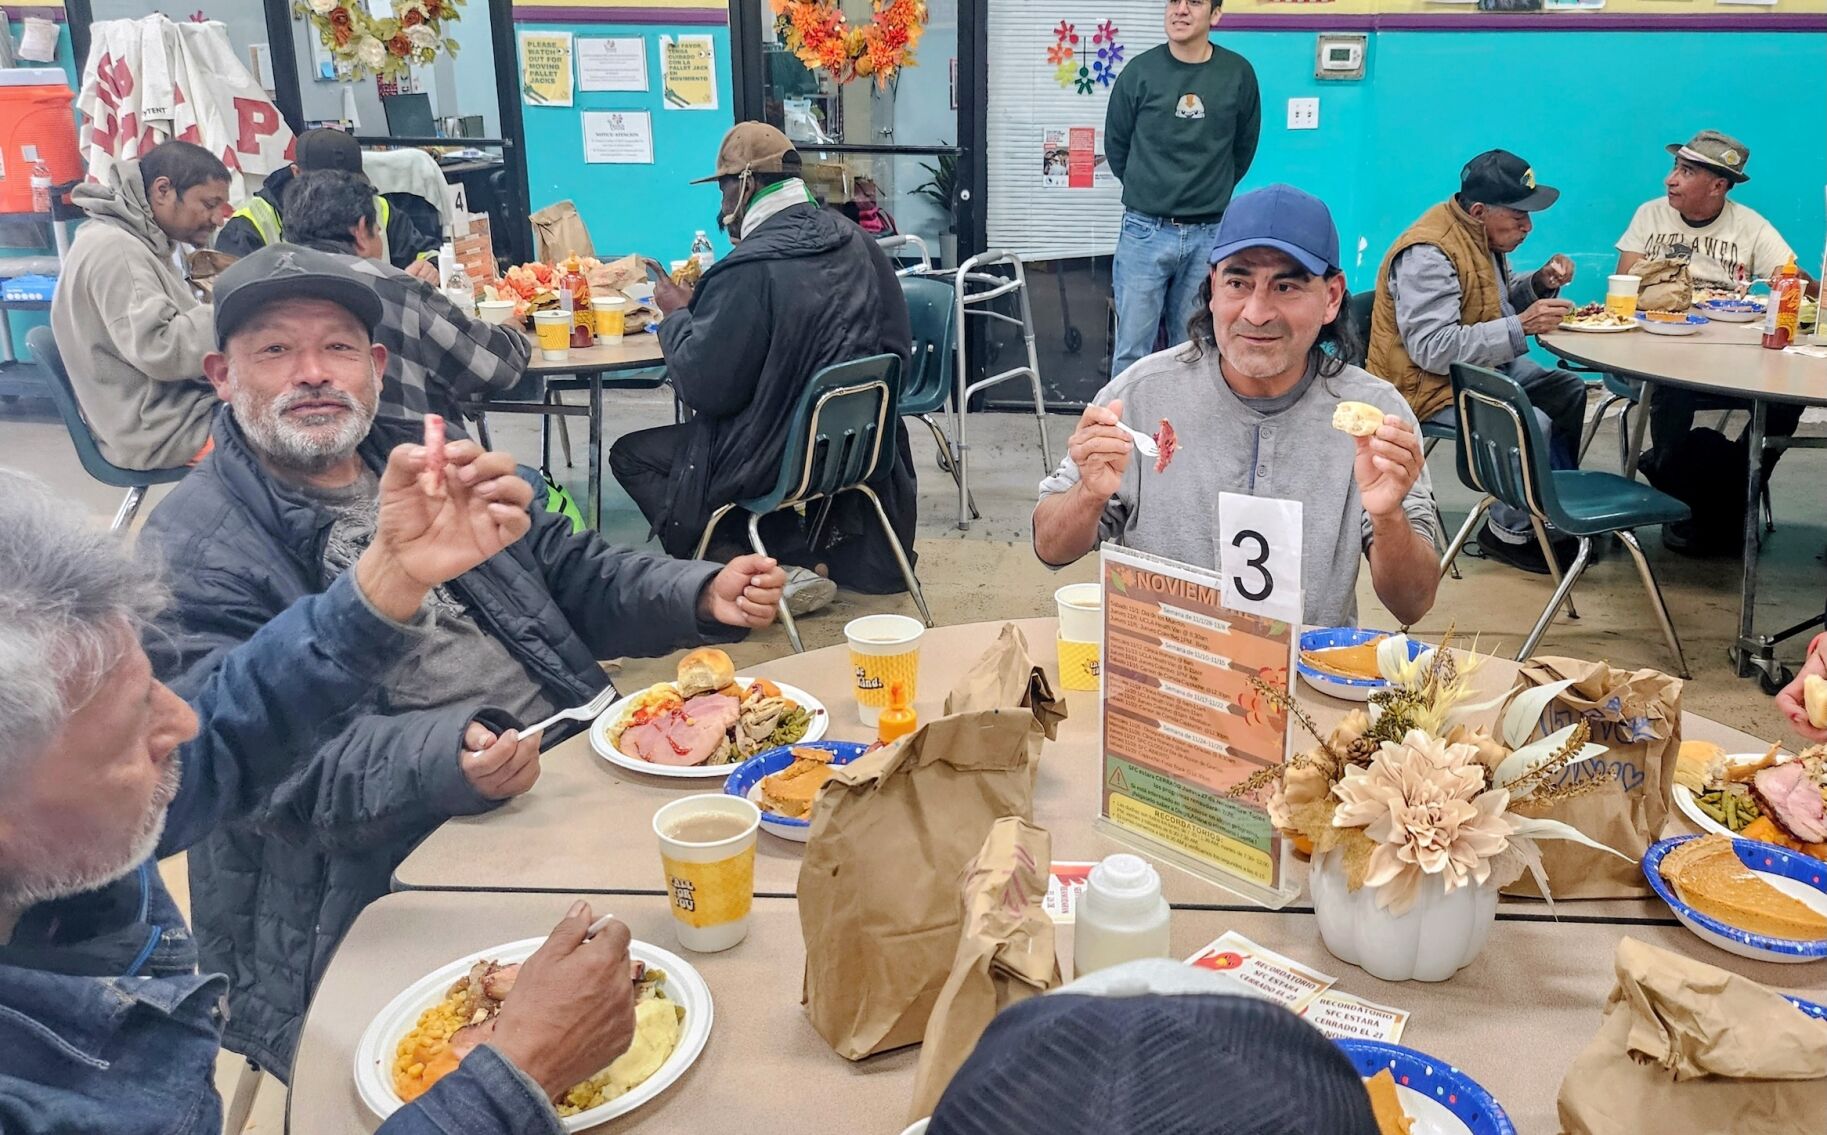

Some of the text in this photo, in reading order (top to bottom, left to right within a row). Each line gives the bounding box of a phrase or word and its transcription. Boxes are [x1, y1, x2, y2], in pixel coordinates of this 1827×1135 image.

[455, 192, 463, 212] 4
[1232, 530, 1274, 602] 3
[1240, 973, 1276, 993] CERRADO
[1276, 989, 1286, 998] EL
[1254, 960, 1316, 990] RECORDATORIO
[1254, 970, 1268, 980] SFC
[1320, 998, 1393, 1020] RECORDATORIO
[1325, 1009, 1342, 1019] SFC
[1314, 1016, 1358, 1034] CERRADO
[1360, 1028, 1370, 1036] EL
